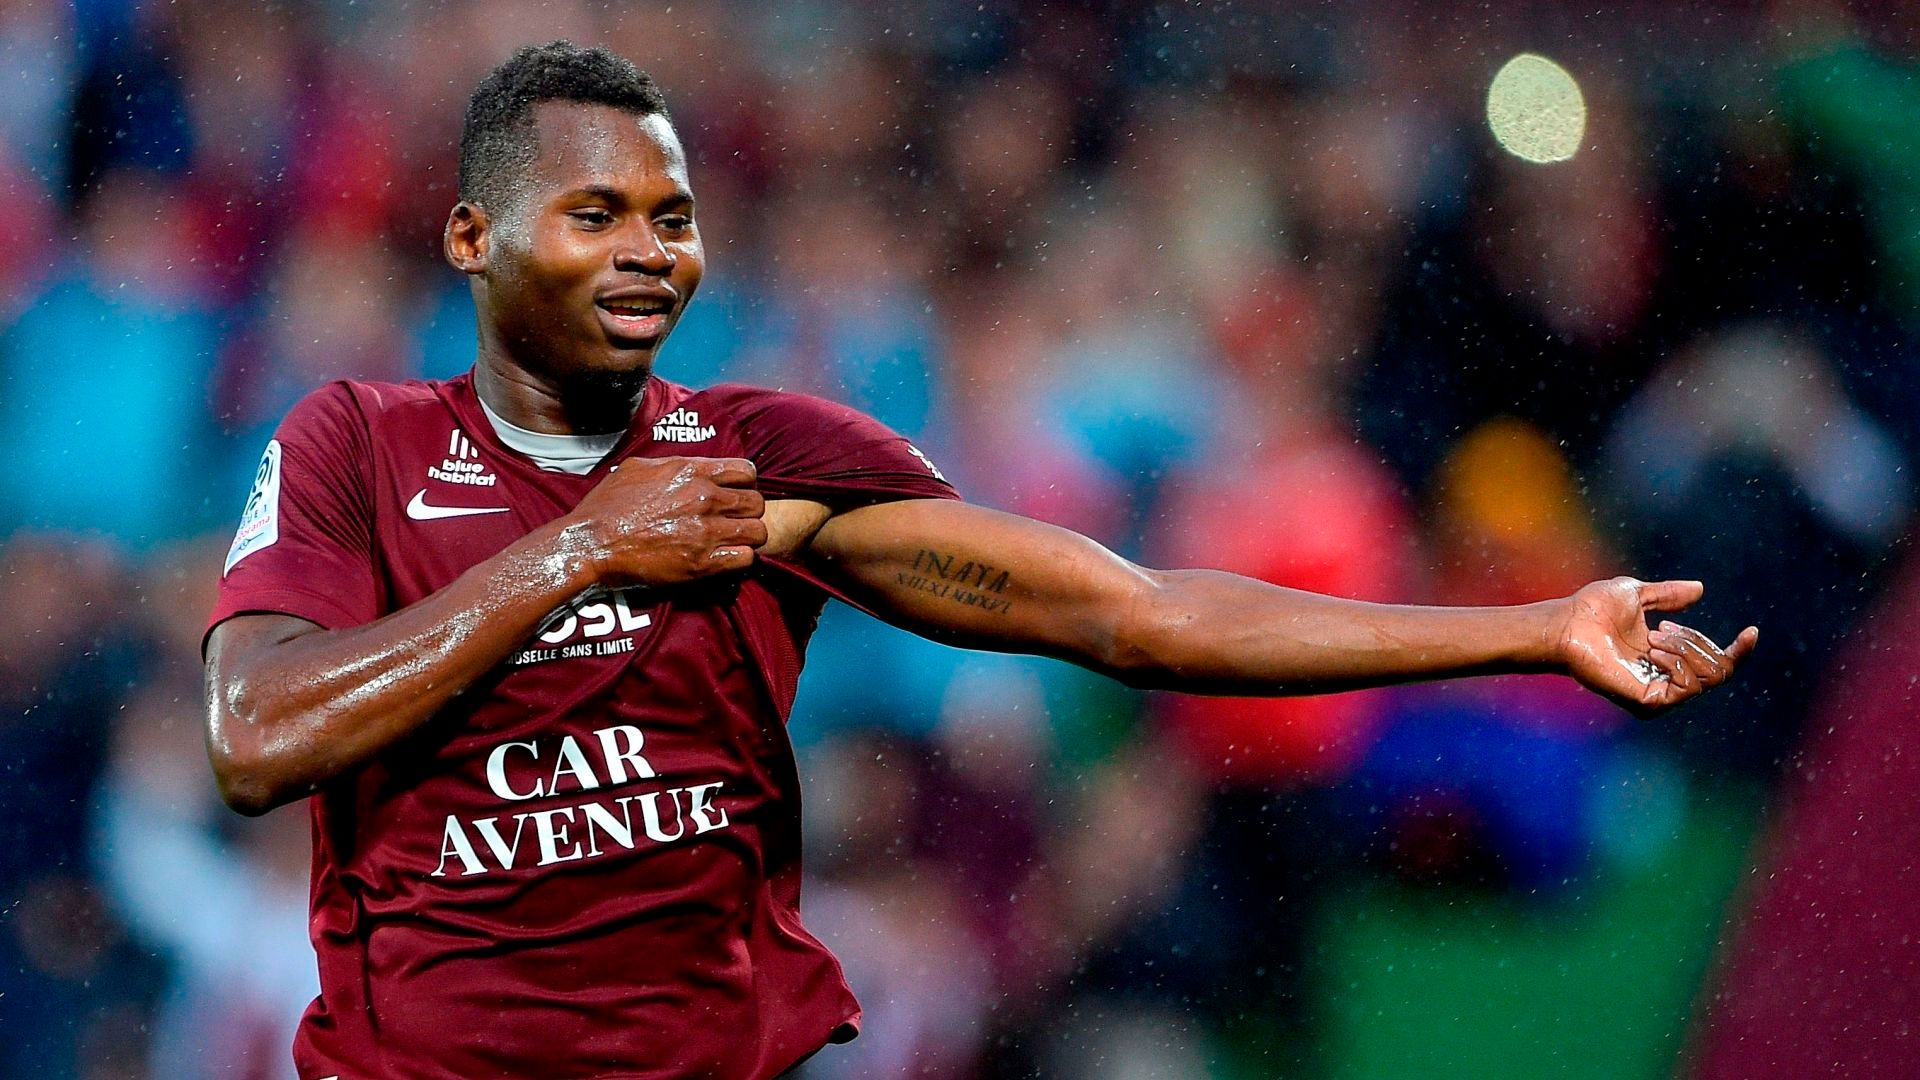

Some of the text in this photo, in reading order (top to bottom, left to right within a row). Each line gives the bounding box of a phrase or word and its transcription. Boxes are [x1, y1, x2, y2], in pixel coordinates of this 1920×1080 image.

[652, 425, 717, 442] INTERIM
[428, 466, 496, 486] habitat
[442, 459, 484, 473] blue
[561, 643, 592, 658] SANS
[596, 637, 635, 655] LIMITE
[486, 725, 656, 800] CAR
[430, 781, 729, 877] AVENUE
